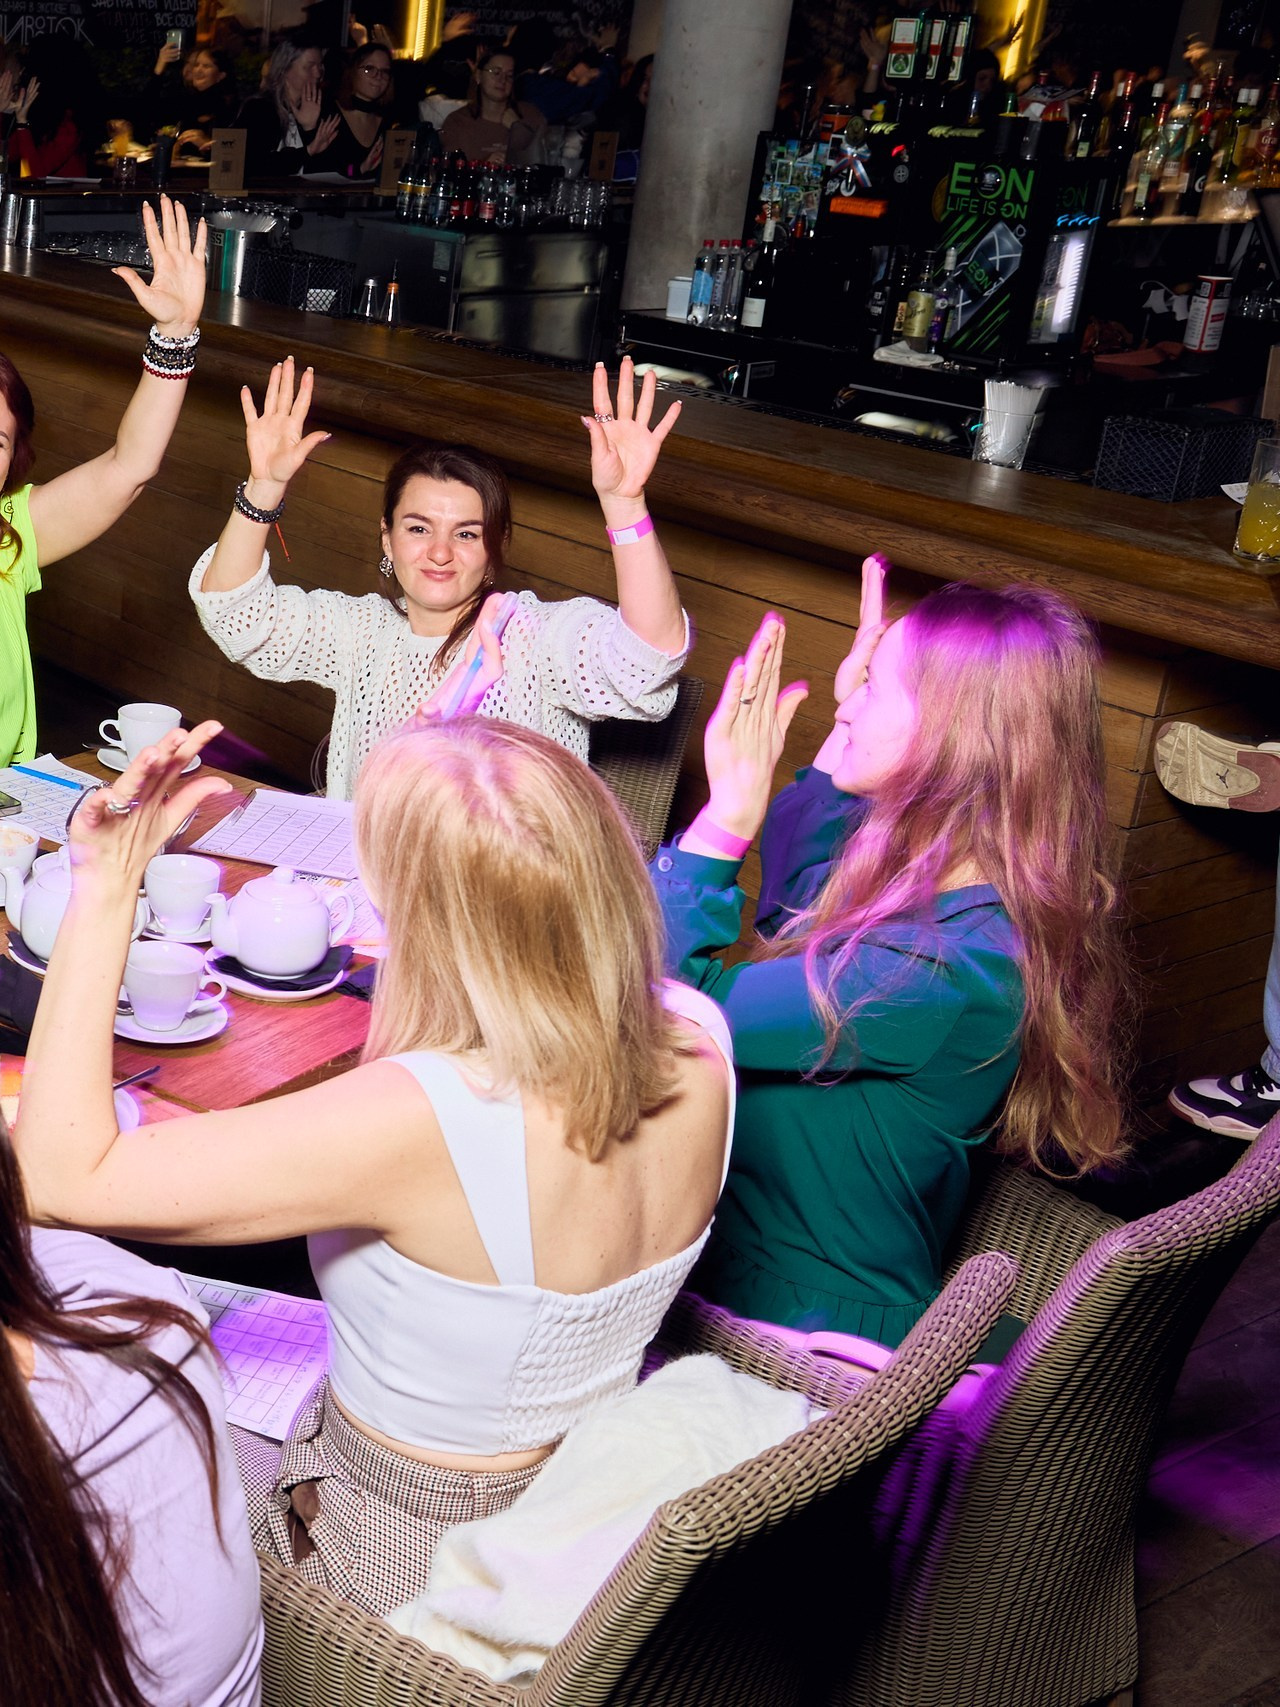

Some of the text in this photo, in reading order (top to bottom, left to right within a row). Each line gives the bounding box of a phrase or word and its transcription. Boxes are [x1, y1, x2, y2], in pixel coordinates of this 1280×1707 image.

[949, 161, 1035, 204] EON
[946, 195, 980, 215] LIFE
[983, 200, 997, 216] IS
